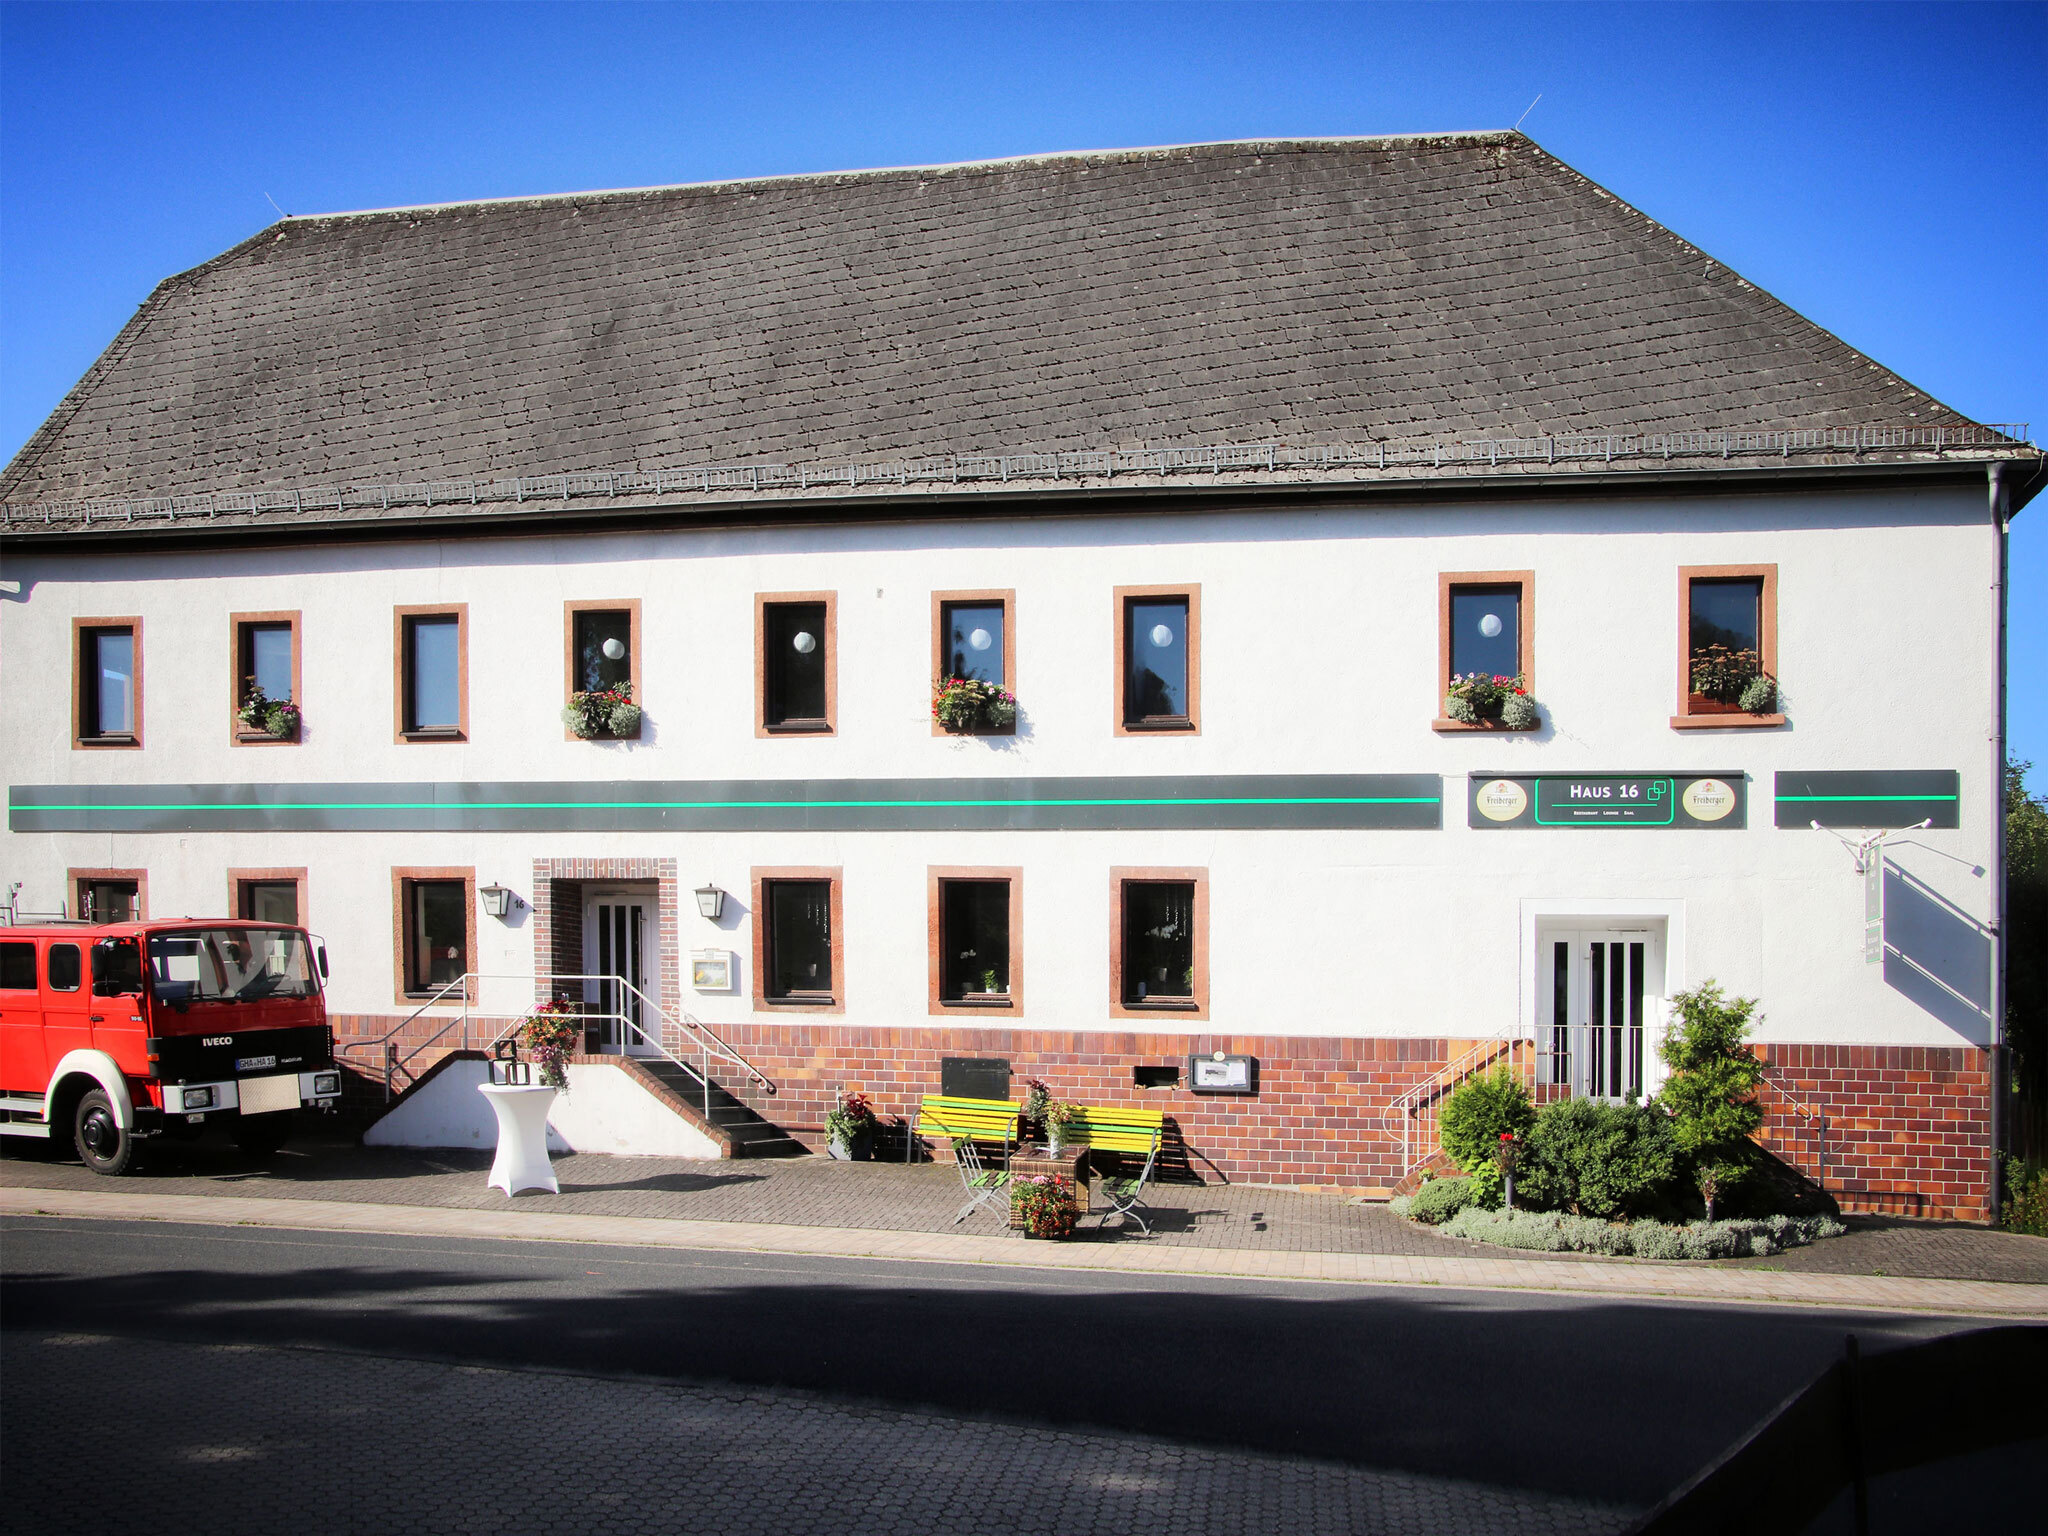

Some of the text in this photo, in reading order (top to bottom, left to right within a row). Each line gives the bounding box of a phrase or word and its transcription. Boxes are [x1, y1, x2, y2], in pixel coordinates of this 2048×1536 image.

[1570, 784, 1639, 798] HAUS 16
[1486, 796, 1518, 806] Freiberger
[1693, 795, 1725, 806] Freiberger
[514, 899, 525, 909] 16
[202, 1036, 233, 1047] IVECO
